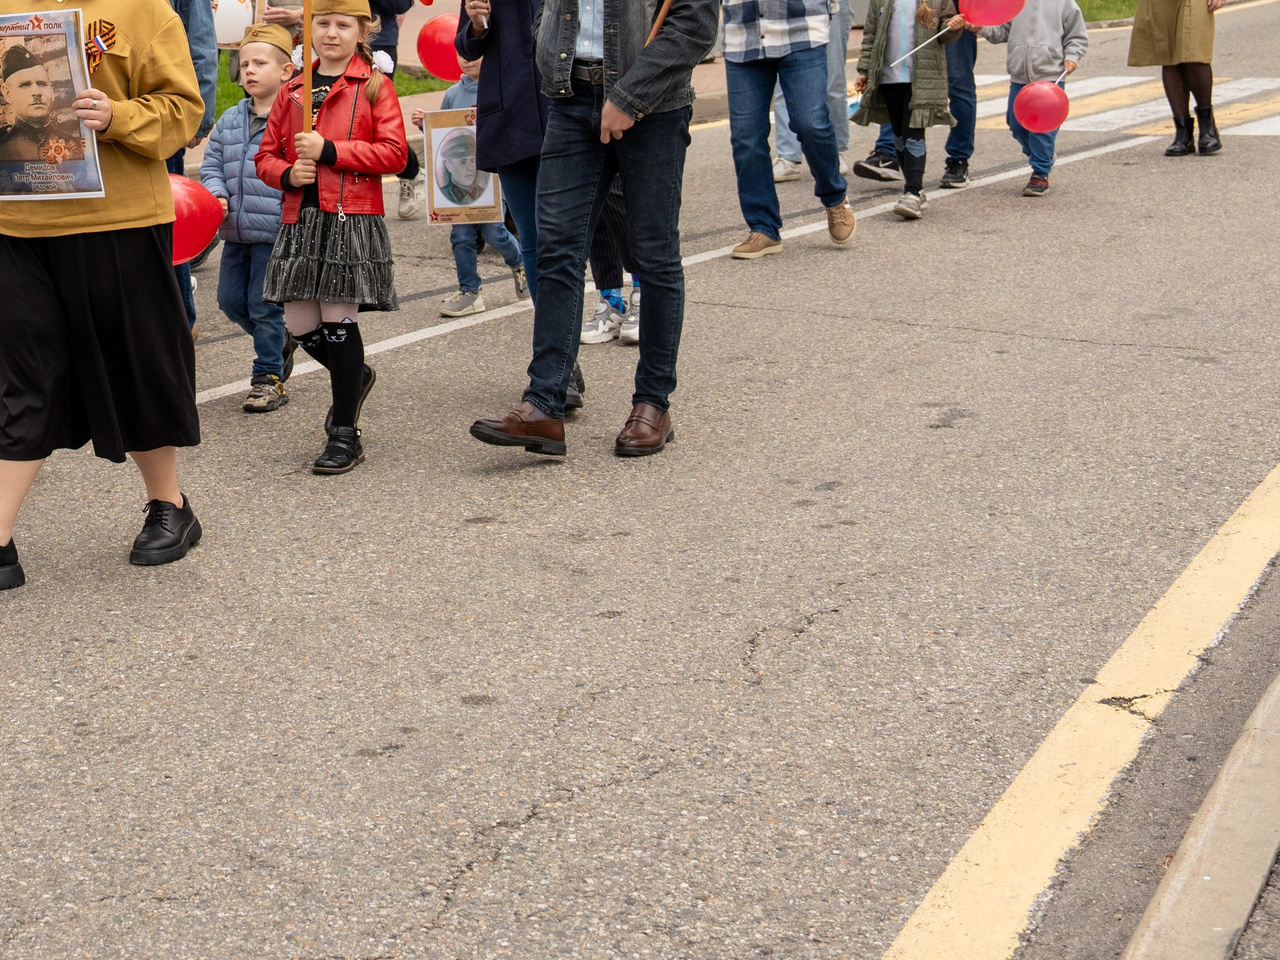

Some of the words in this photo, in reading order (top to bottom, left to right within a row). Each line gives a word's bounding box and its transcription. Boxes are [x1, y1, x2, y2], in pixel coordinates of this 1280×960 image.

[25, 163, 56, 172] Демидов
[32, 173, 74, 182] Михайлович
[32, 183, 57, 191] рядовой
